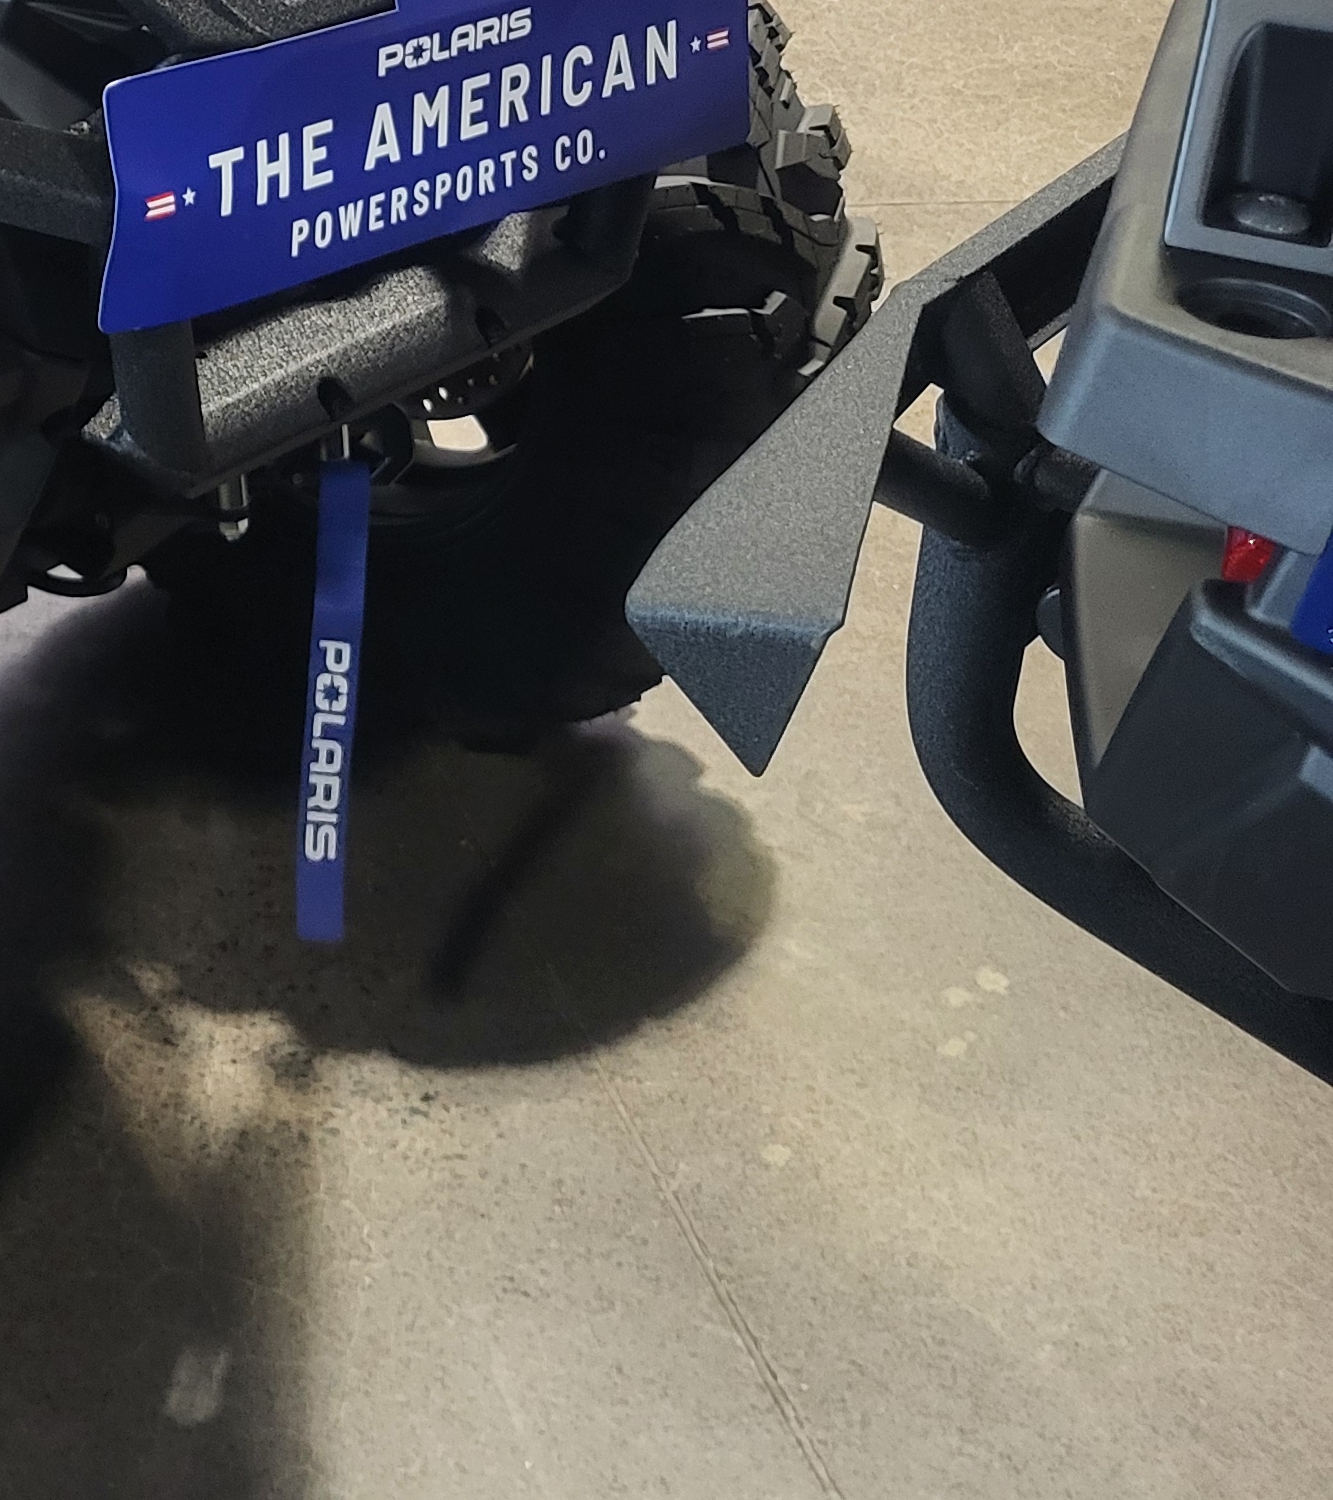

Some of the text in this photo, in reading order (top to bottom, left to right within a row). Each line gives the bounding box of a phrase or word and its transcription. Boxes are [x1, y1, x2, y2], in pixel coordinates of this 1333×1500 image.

[208, 19, 679, 217] THE AMERICAN
[377, 8, 533, 77] POLARIS
[290, 129, 608, 258] POWERSPORTS CO.
[304, 639, 351, 862] POLARIS
